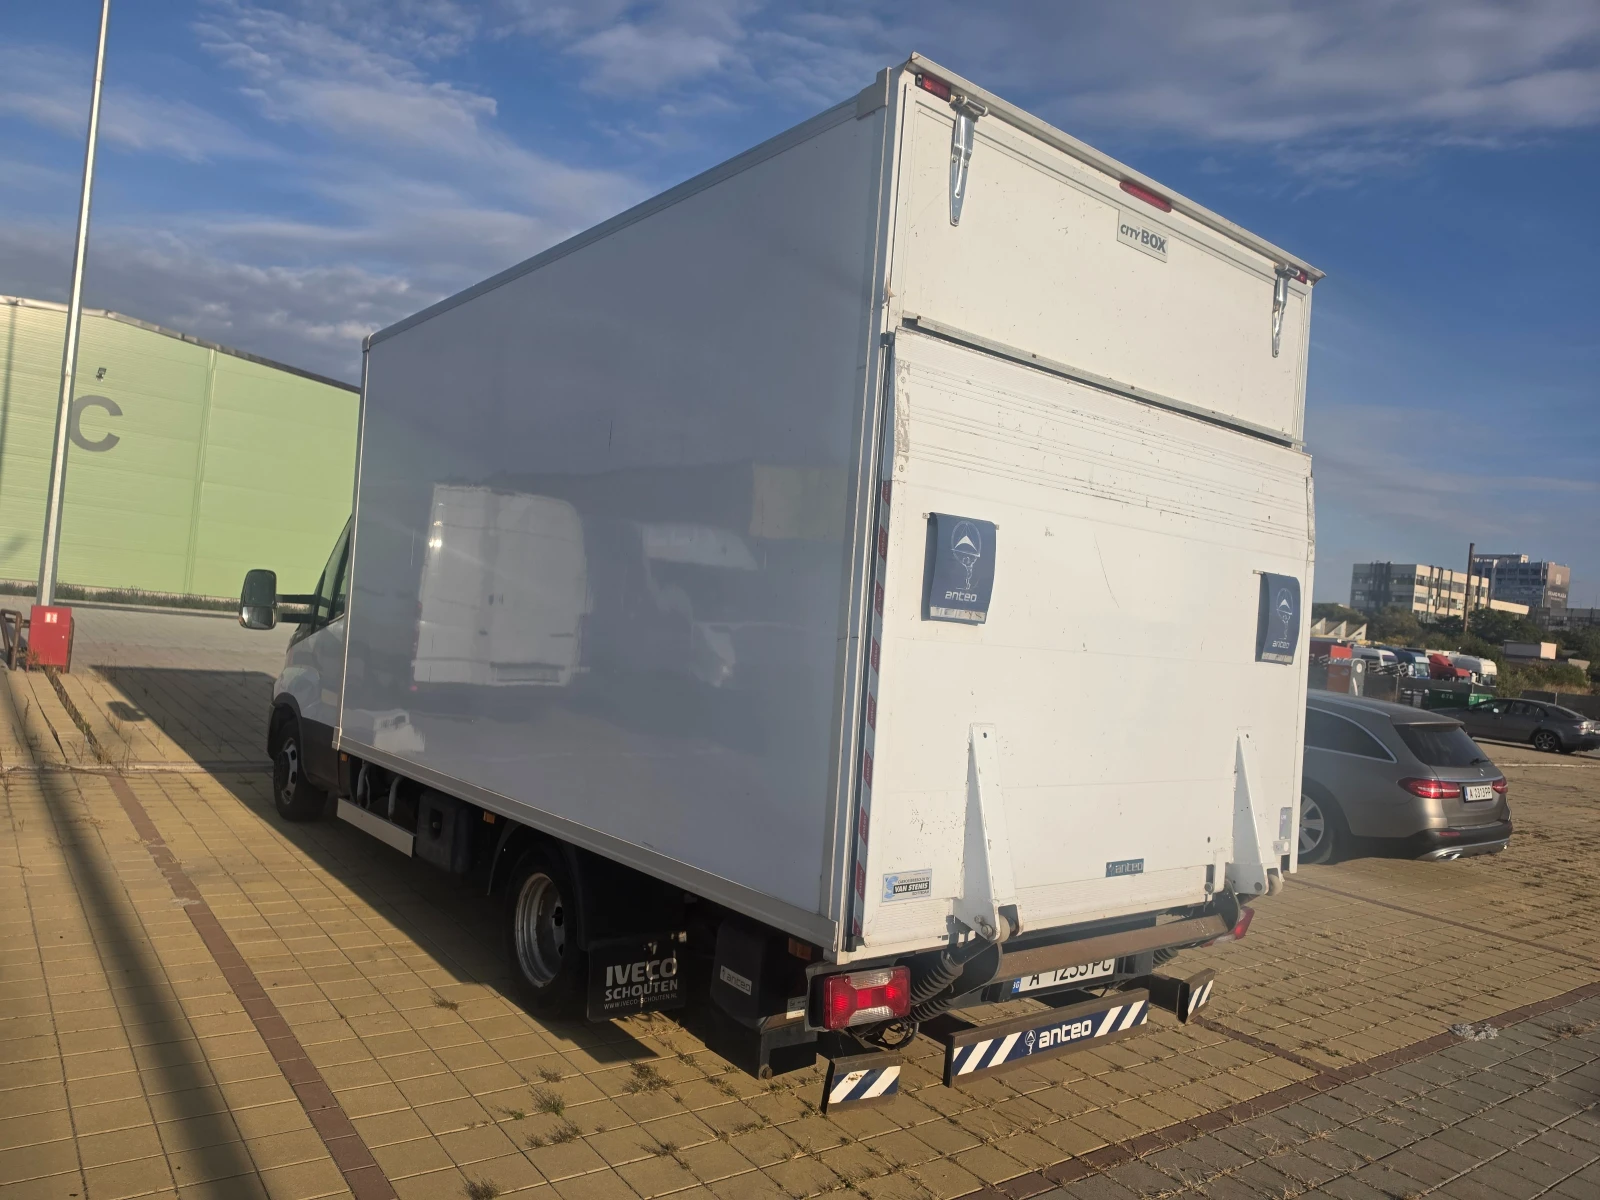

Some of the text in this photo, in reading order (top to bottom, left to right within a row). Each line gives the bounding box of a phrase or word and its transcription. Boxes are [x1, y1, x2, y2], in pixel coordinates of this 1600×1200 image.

[1120, 224, 1167, 253] CITY BOX
[69, 394, 123, 452] C
[945, 590, 977, 602] anteo
[1115, 862, 1143, 873] anteo
[895, 884, 908, 893] VAN
[605, 957, 678, 987] IVECO
[727, 973, 751, 992] anteo
[604, 978, 678, 1002] SCHOUTEN
[1038, 1019, 1092, 1048] anteo
